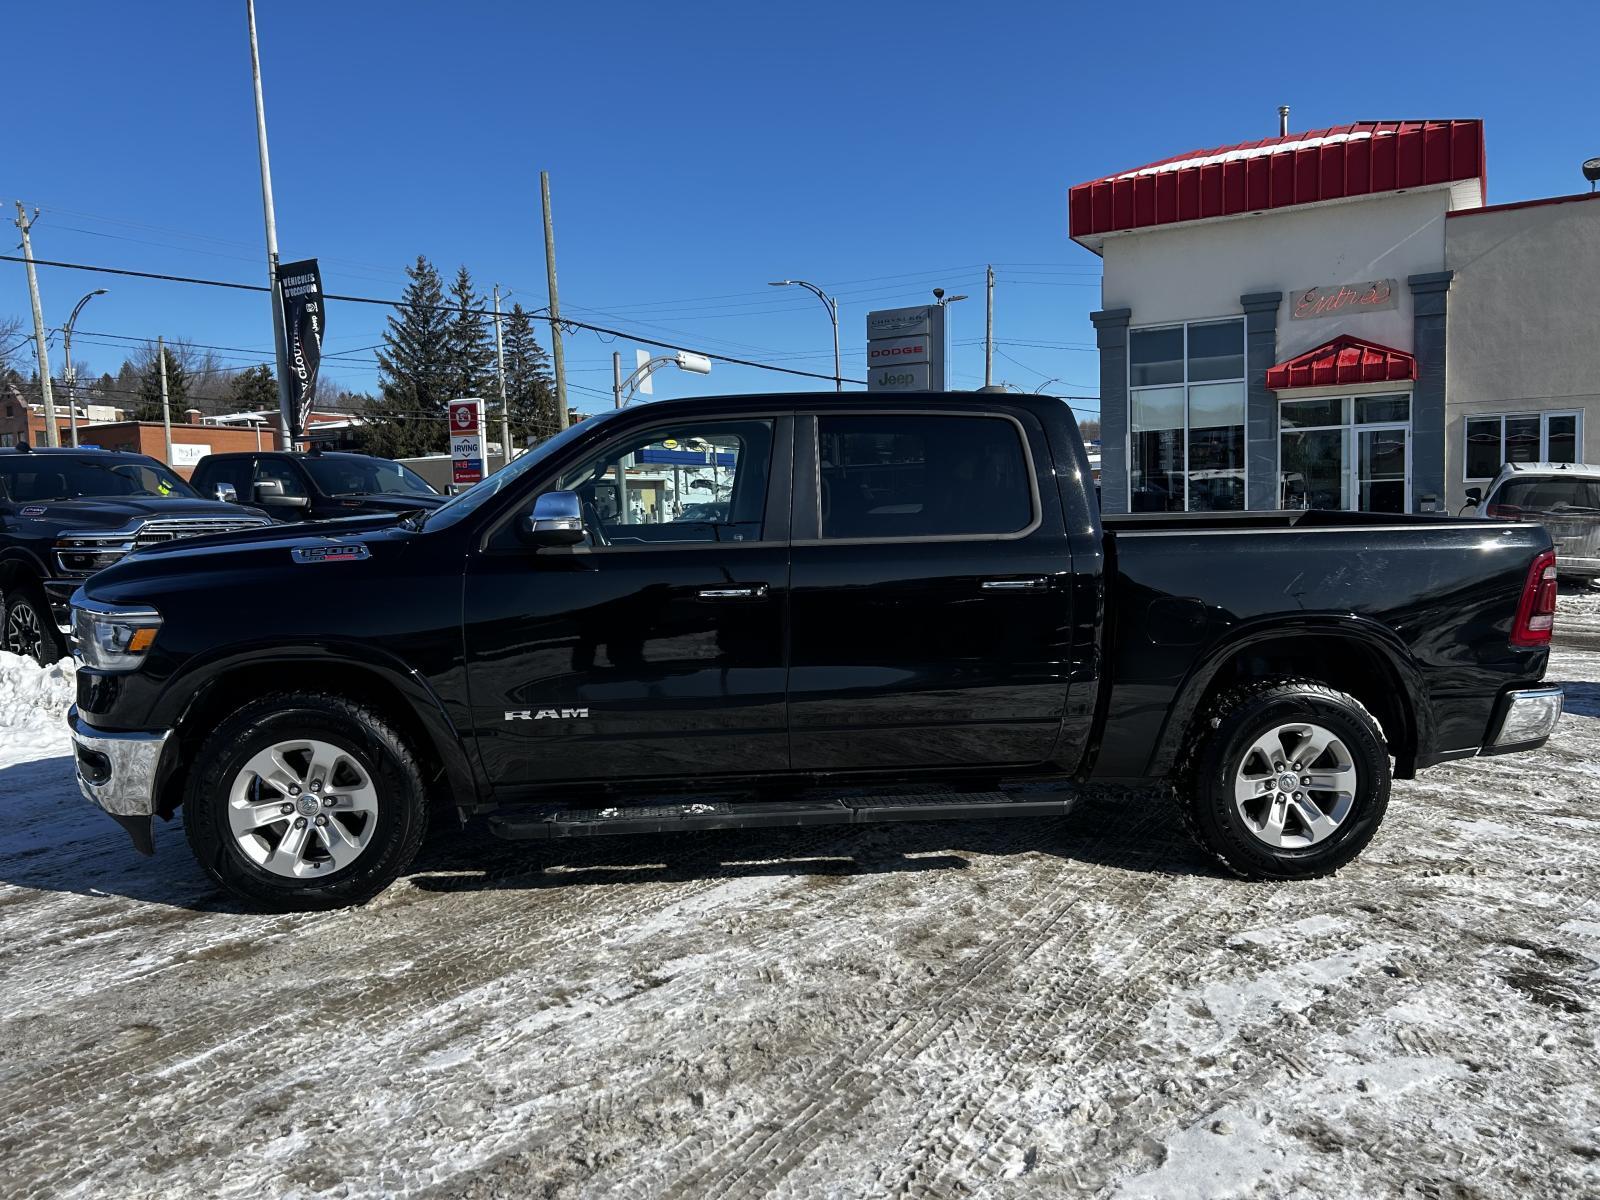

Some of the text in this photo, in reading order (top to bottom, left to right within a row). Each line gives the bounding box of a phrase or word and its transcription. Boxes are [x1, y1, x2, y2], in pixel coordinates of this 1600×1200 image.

[871, 346, 923, 357] DODGE
[878, 372, 914, 386] Jeep
[454, 444, 478, 453] IRVING
[304, 546, 359, 557] 1500
[504, 707, 588, 720] RAM
